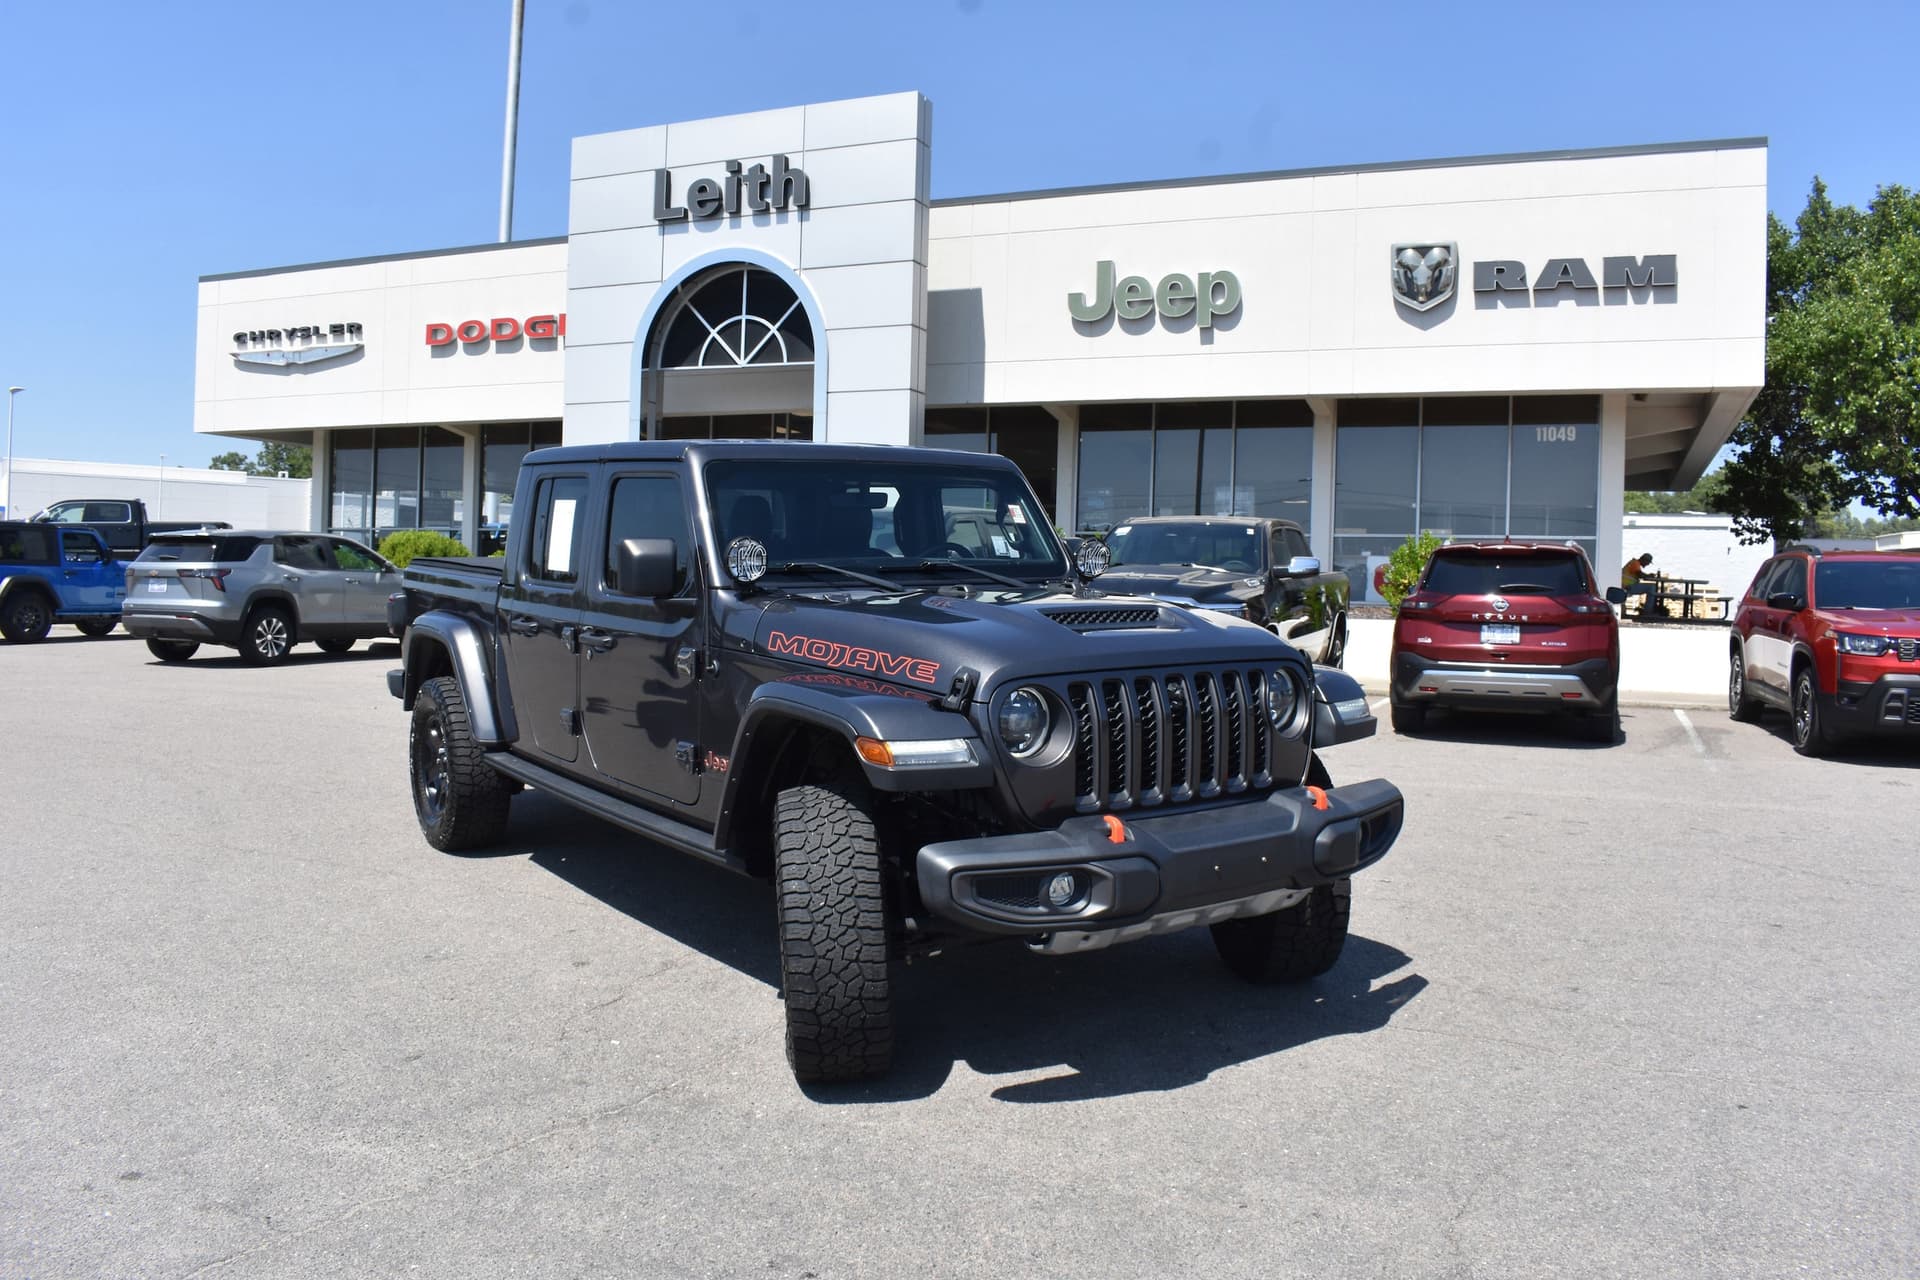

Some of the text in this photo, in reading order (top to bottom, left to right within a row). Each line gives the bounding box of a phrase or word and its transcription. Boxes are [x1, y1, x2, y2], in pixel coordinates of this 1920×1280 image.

[654, 154, 810, 222] Leith
[1474, 254, 1677, 293] RAM
[1068, 260, 1242, 328] Jeep
[233, 322, 363, 344] CHRYSLER
[1536, 425, 1576, 442] 11049
[738, 543, 767, 580] KC
[768, 631, 940, 684] MOJAVE
[704, 750, 729, 772] Jee
